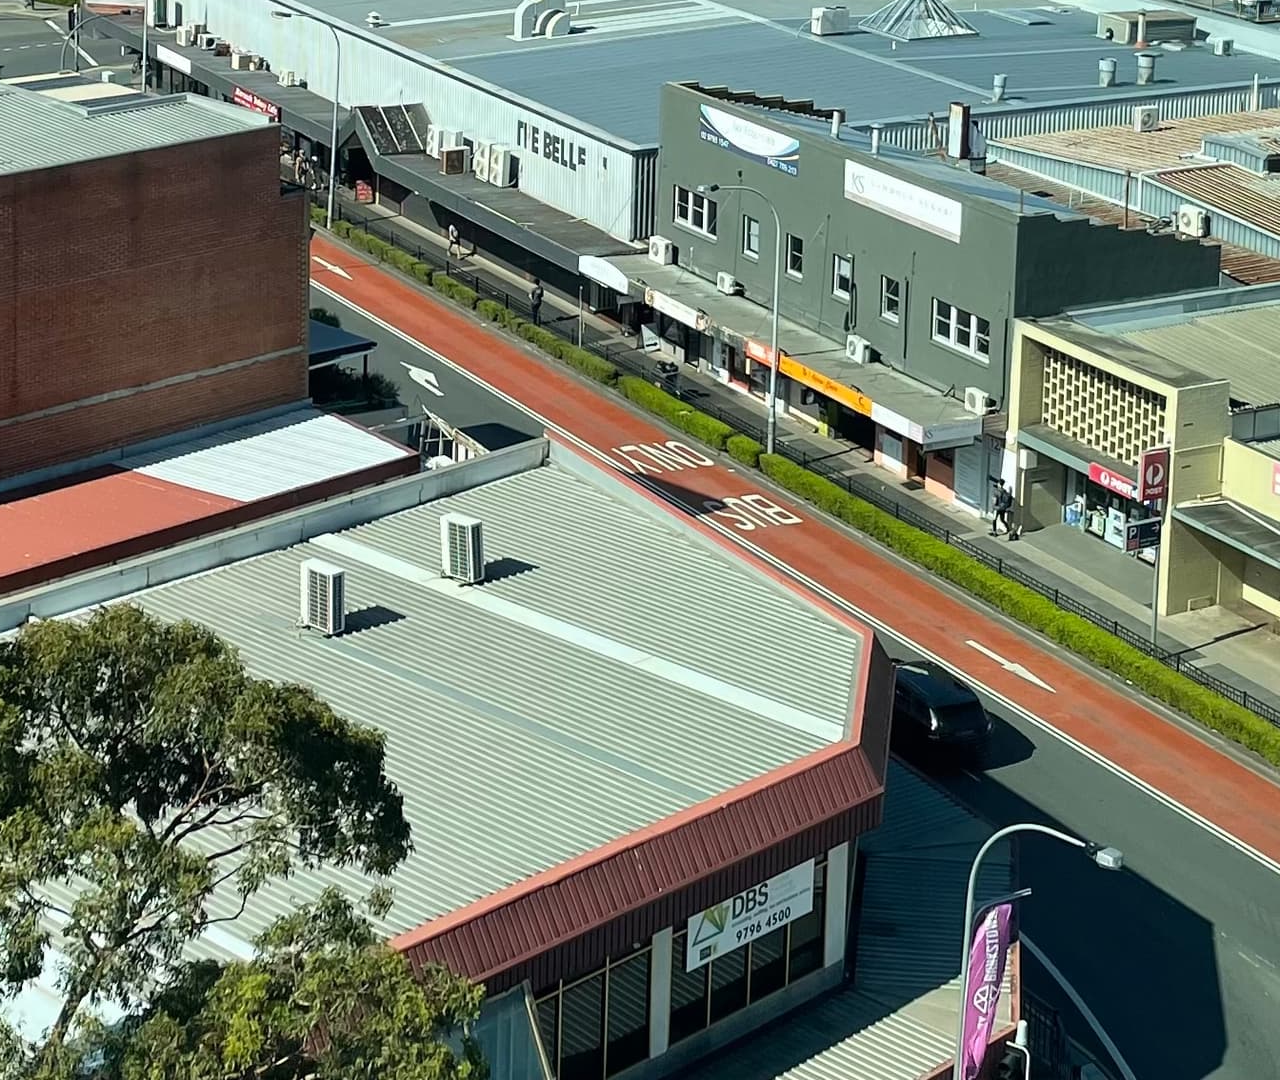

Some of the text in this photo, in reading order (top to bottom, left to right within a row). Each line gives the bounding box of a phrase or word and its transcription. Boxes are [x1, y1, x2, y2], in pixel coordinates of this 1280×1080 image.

[612, 440, 714, 475] ONLY
[702, 494, 803, 531] BUS
[731, 882, 769, 921] DBS
[735, 921, 762, 943] 9796
[765, 906, 791, 928] 4500
